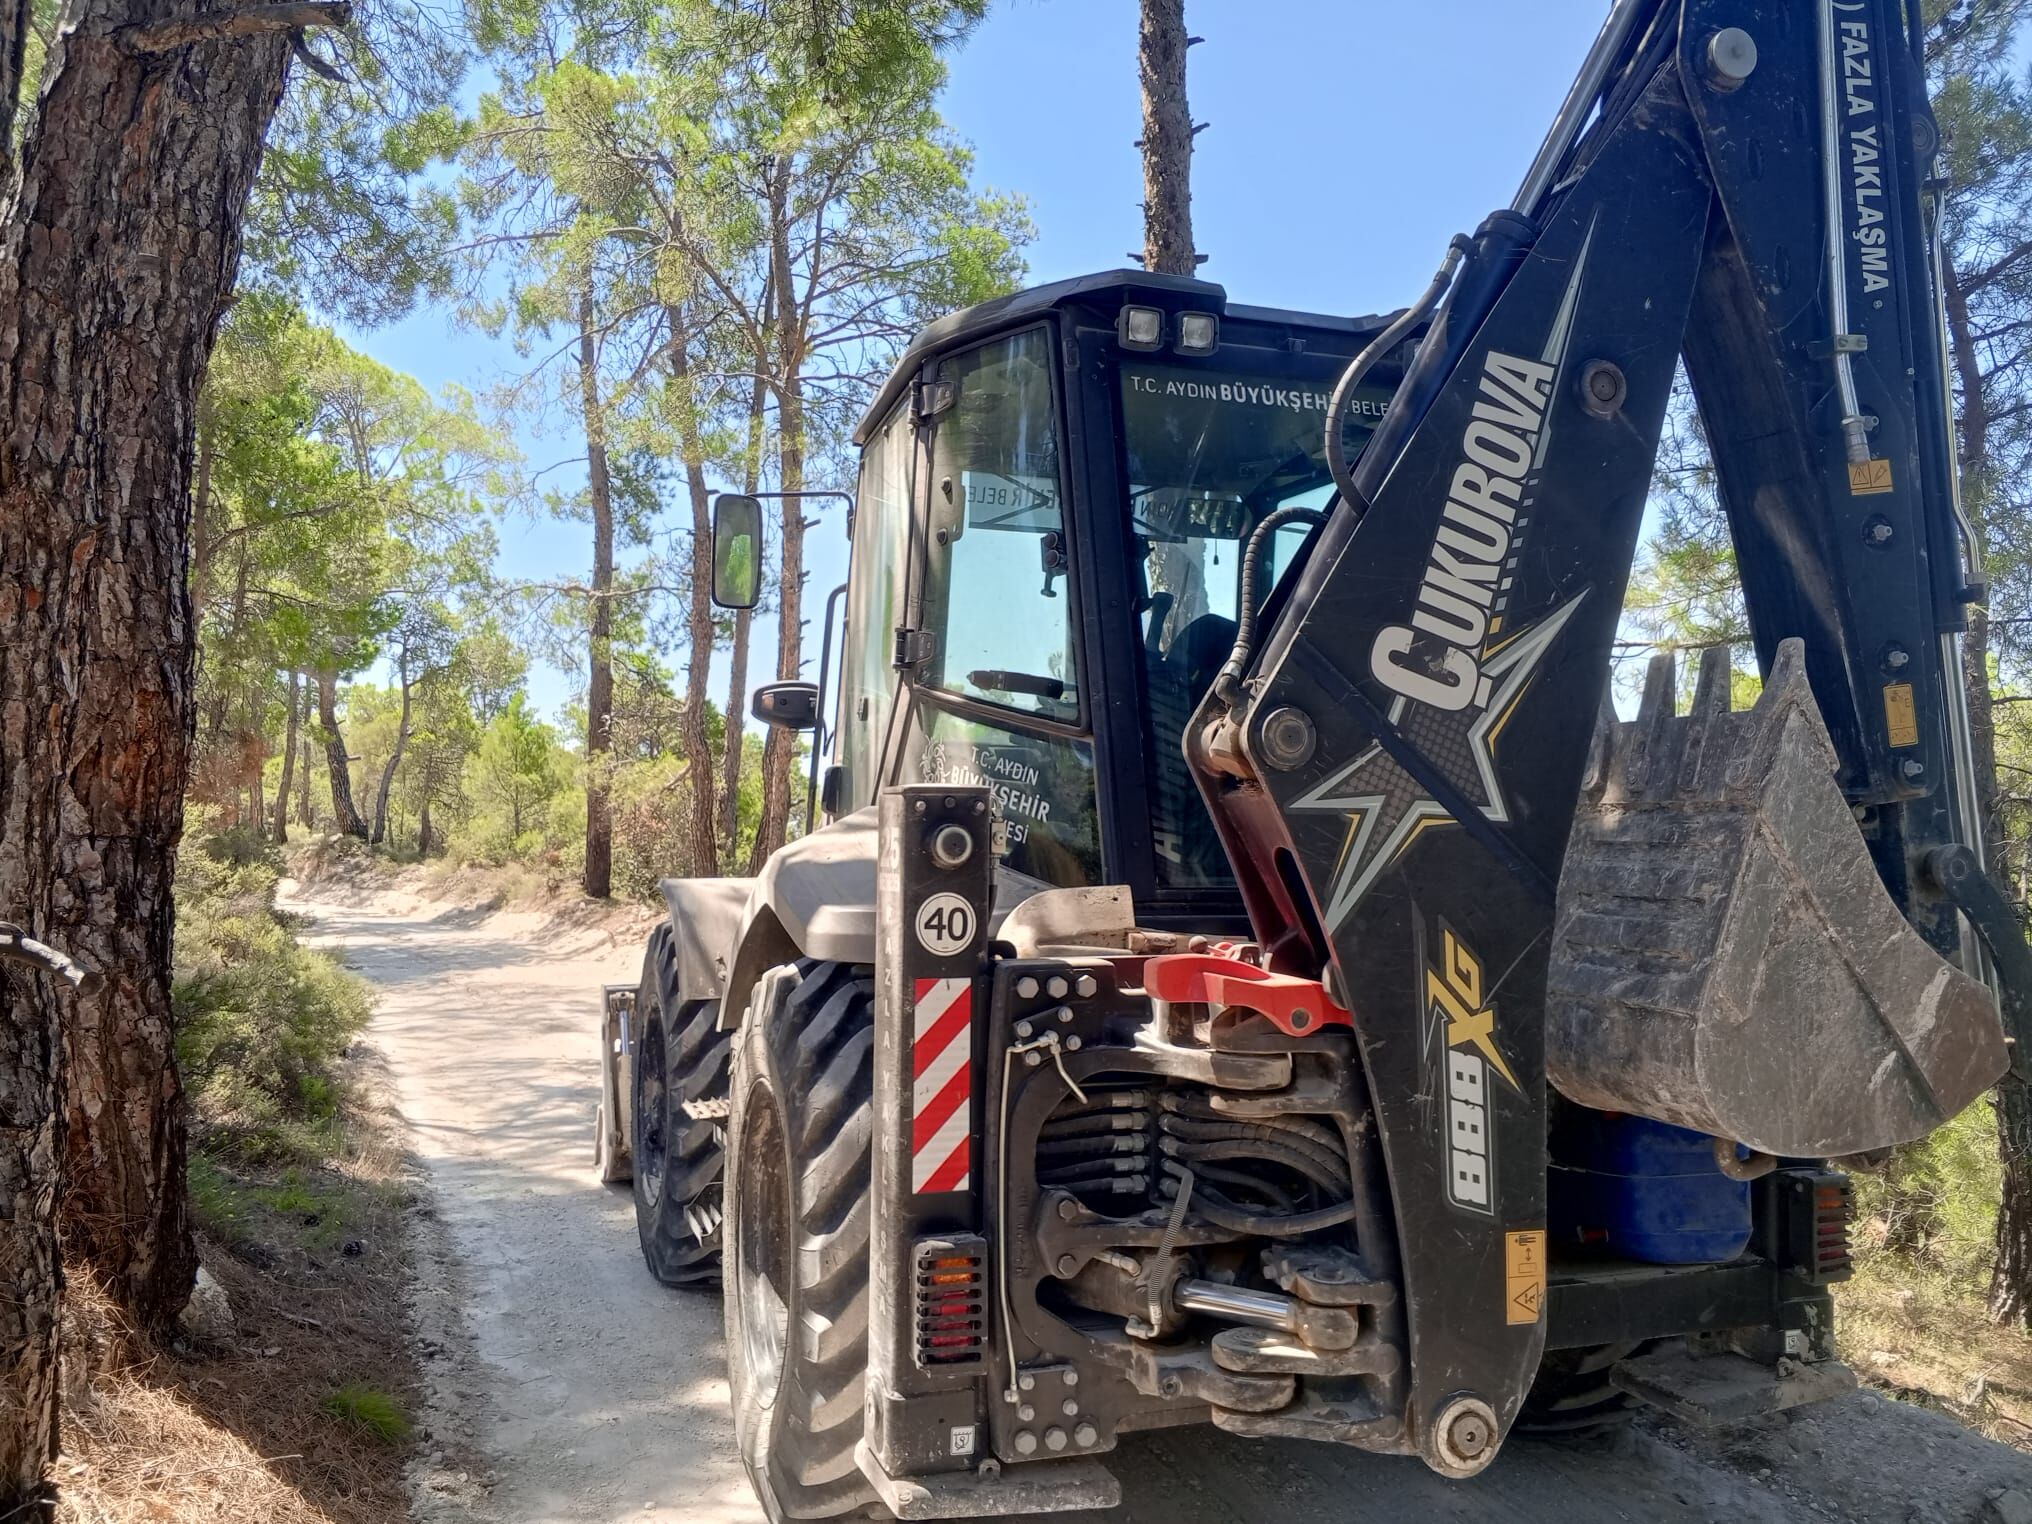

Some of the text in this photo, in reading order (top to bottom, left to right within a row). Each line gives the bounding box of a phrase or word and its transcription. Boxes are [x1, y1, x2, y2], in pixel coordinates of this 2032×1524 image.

[1840, 22, 1875, 117] FAZLA
[1850, 125, 1889, 294] YAKLAŞMA
[1131, 376, 1389, 417] T.C. AYDIN BÜYÜKŞEH BELE
[1371, 351, 1555, 713] ÇUKUROVA
[971, 746, 1039, 787] T.C. AYDIN
[924, 907, 968, 941] 40
